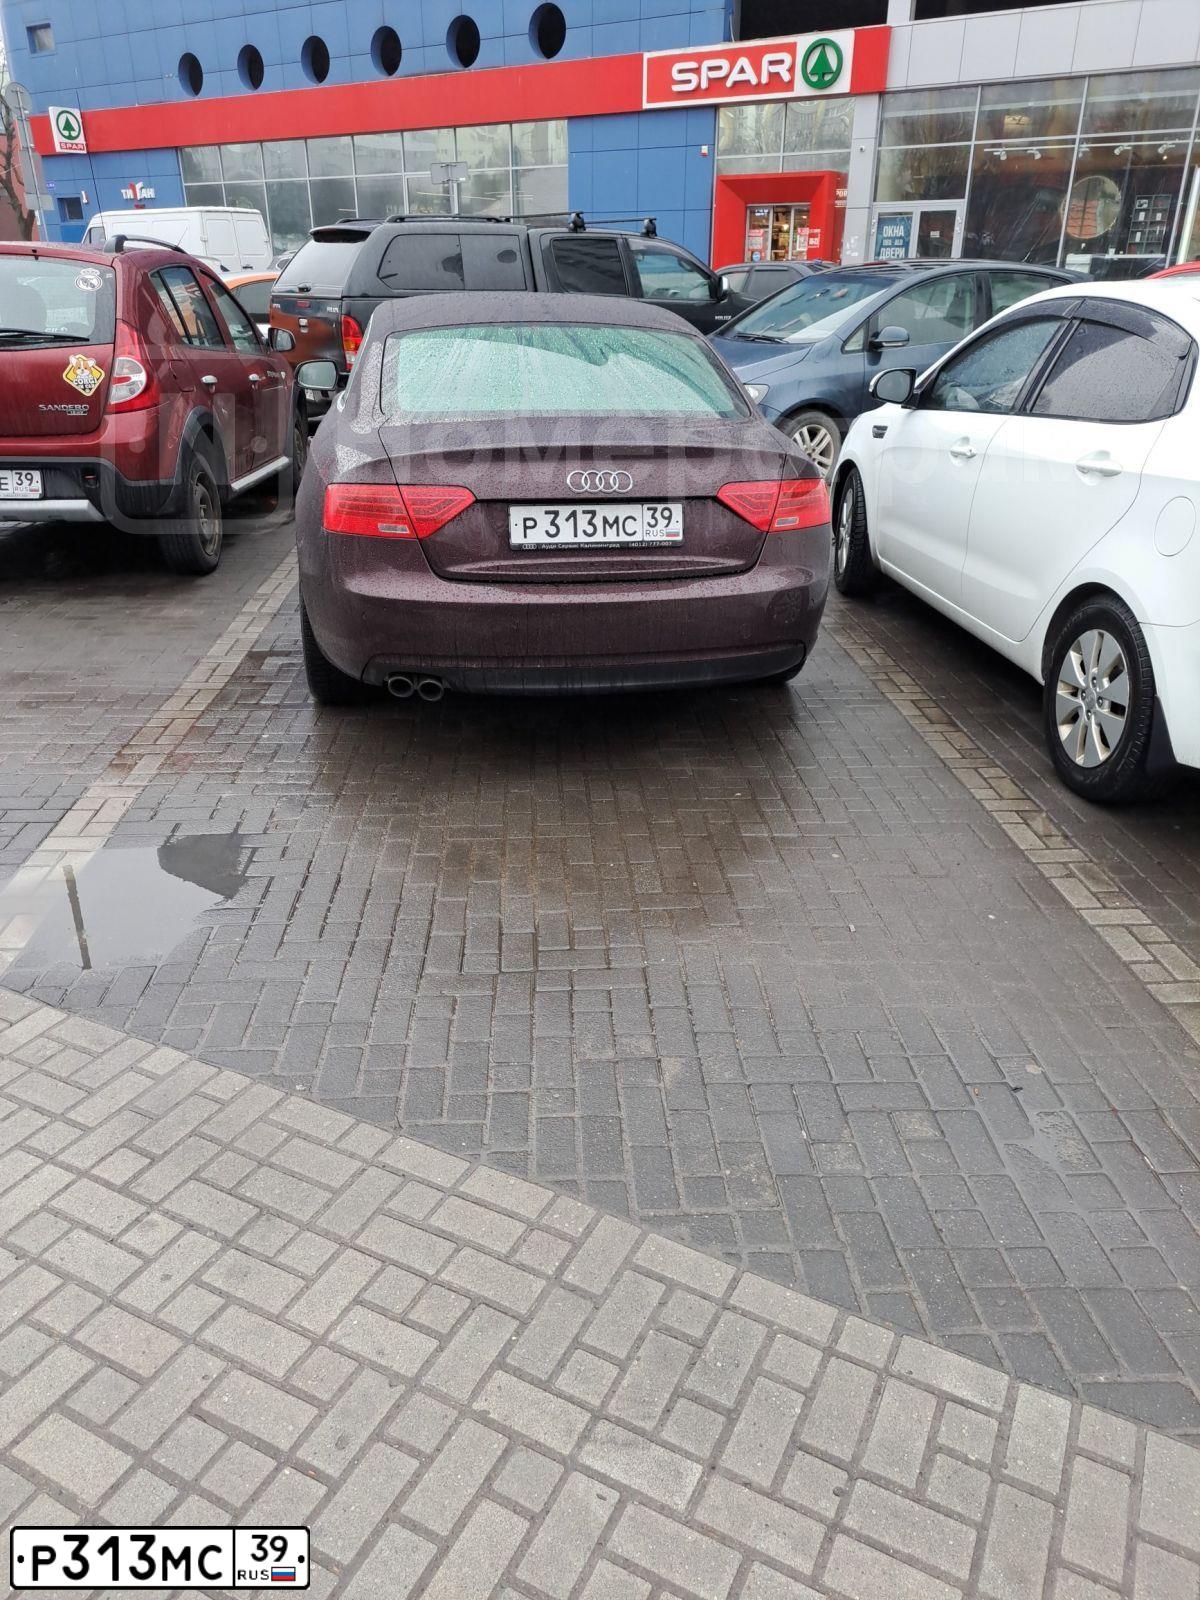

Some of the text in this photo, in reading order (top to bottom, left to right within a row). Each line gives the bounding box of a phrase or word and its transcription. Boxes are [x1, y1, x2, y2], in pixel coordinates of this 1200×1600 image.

[671, 52, 793, 92] SPAR
[60, 142, 84, 150] SPAR
[883, 224, 904, 237] ОКНА
[880, 247, 905, 259] ДВЕРИ
[15, 471, 34, 486] 39
[522, 506, 673, 539] Р313МС 39
[645, 529, 665, 537] RUS
